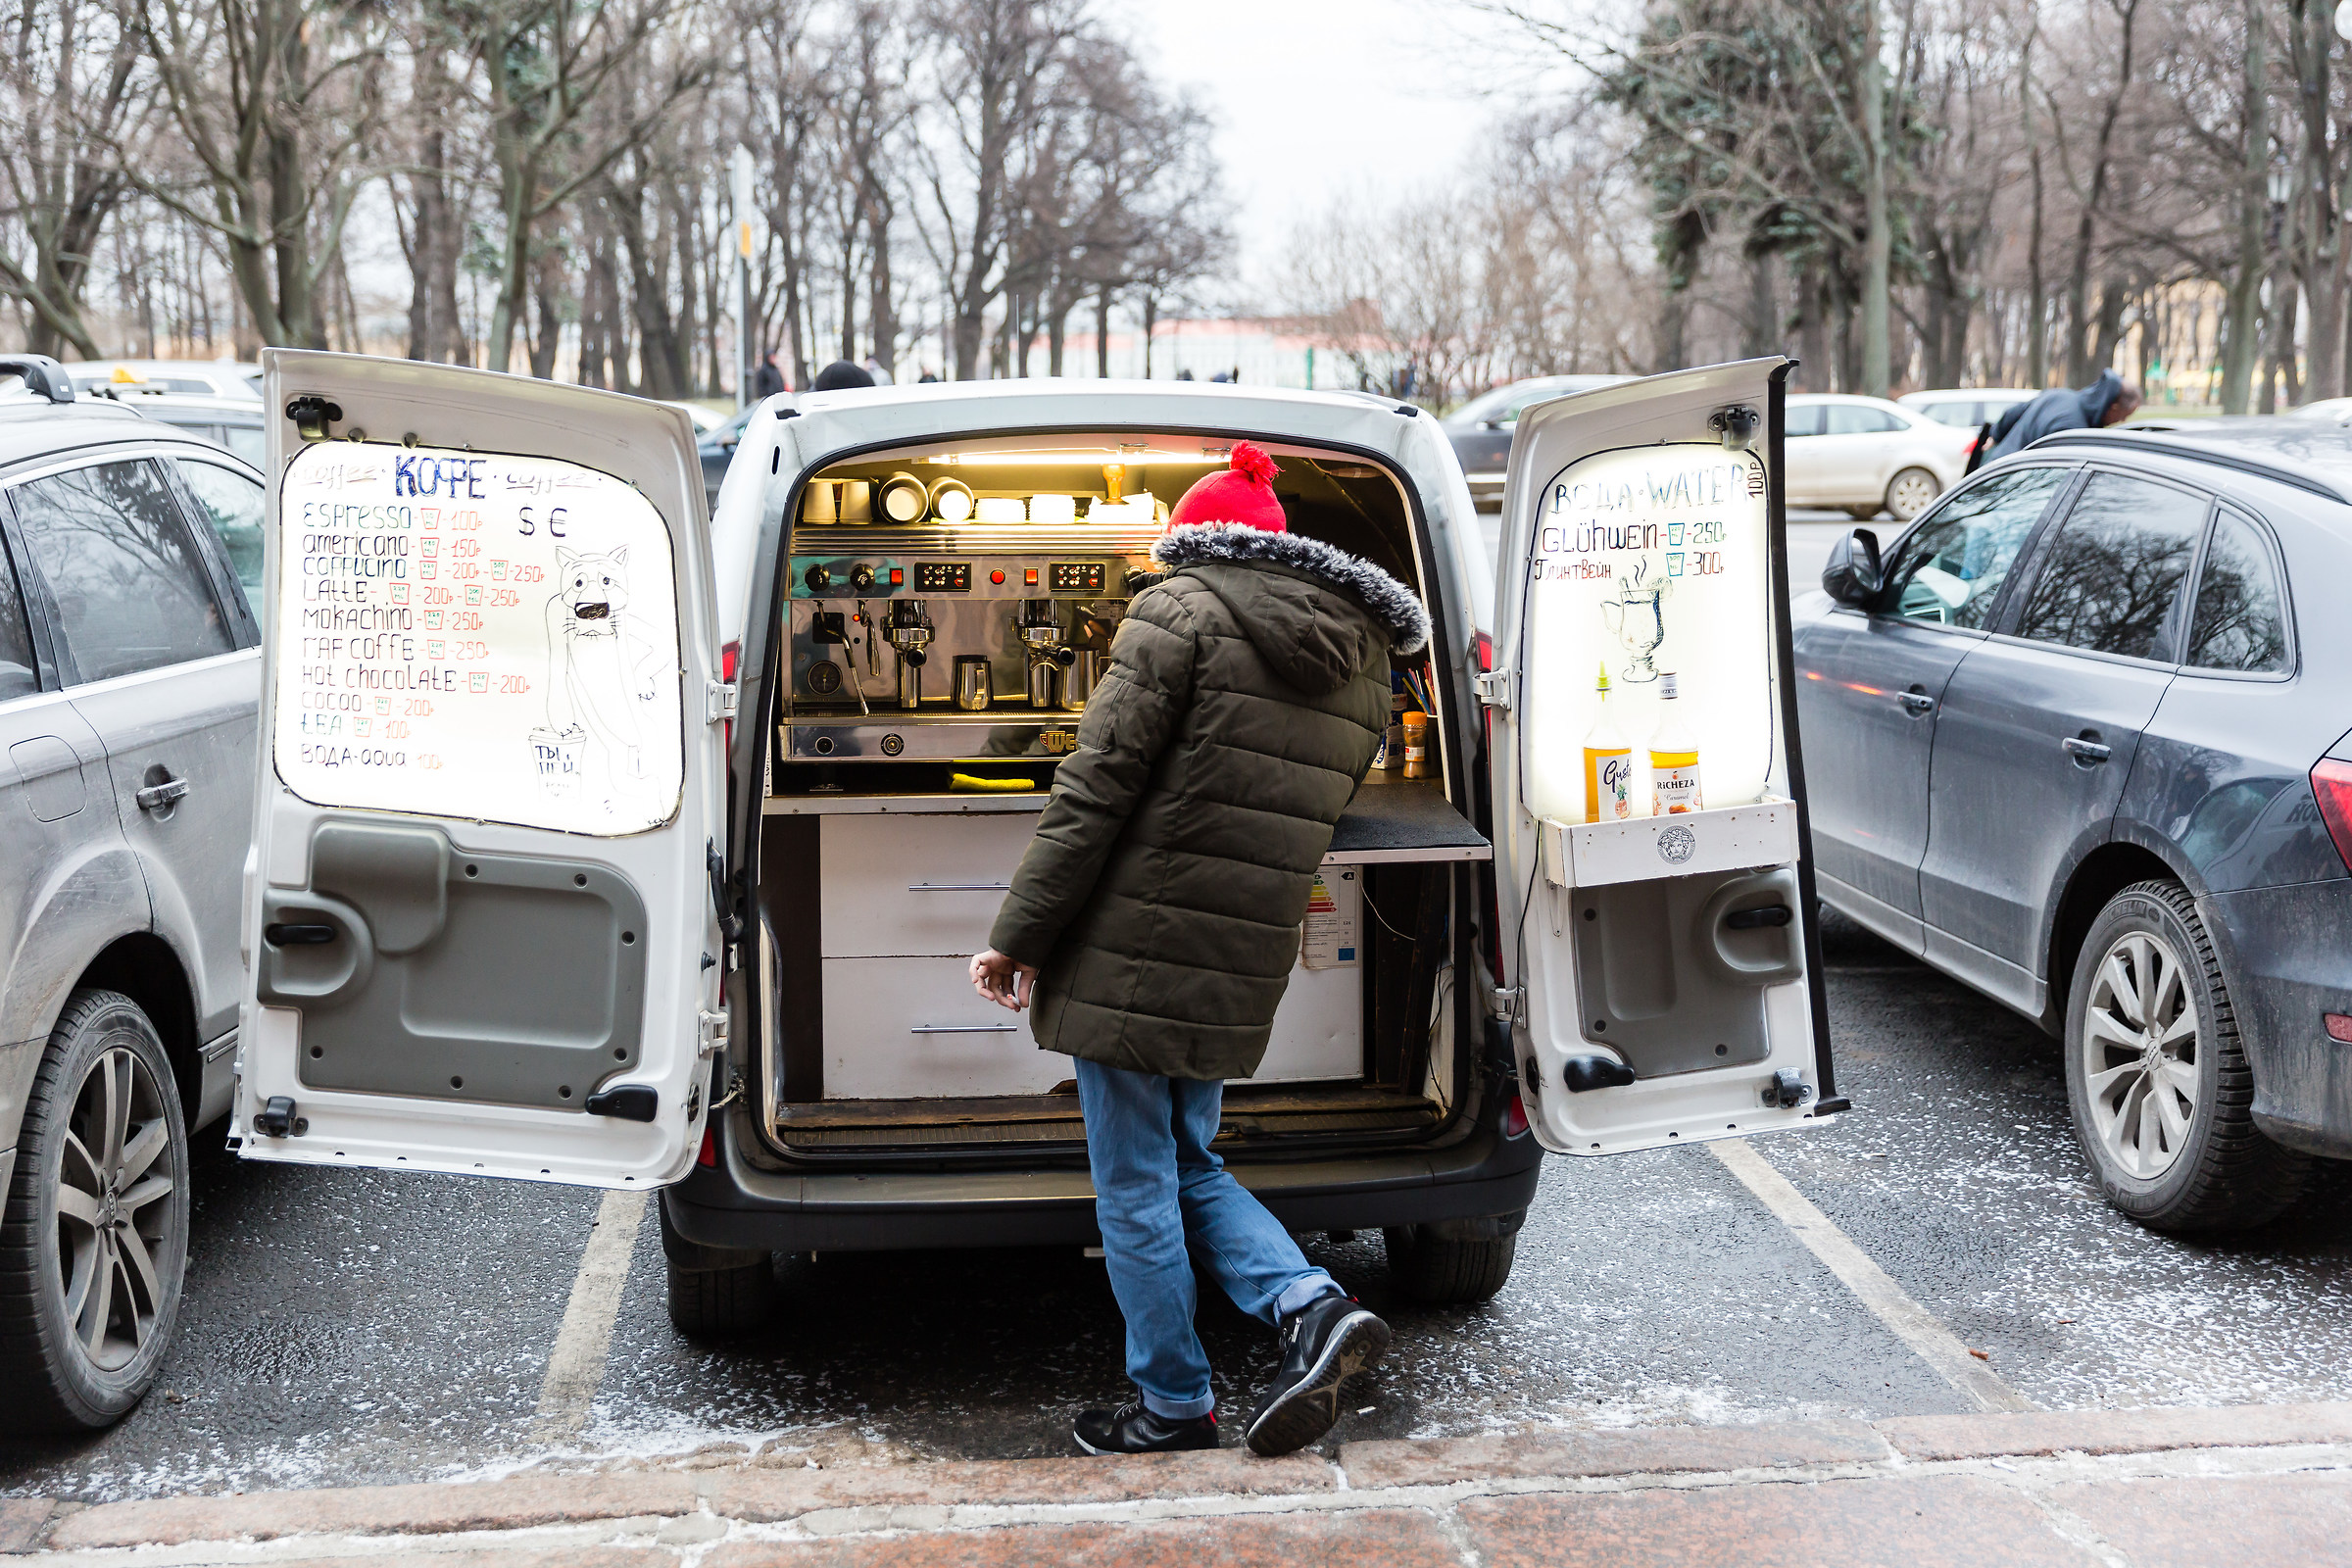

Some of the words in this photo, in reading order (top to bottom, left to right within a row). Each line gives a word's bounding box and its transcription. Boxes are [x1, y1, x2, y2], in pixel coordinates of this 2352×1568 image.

[396, 453, 487, 500] КОФЕ
[1646, 464, 1746, 509] WATER
[518, 504, 535, 537] $
[548, 508, 567, 538] €
[1048, 733, 1077, 752] WE
